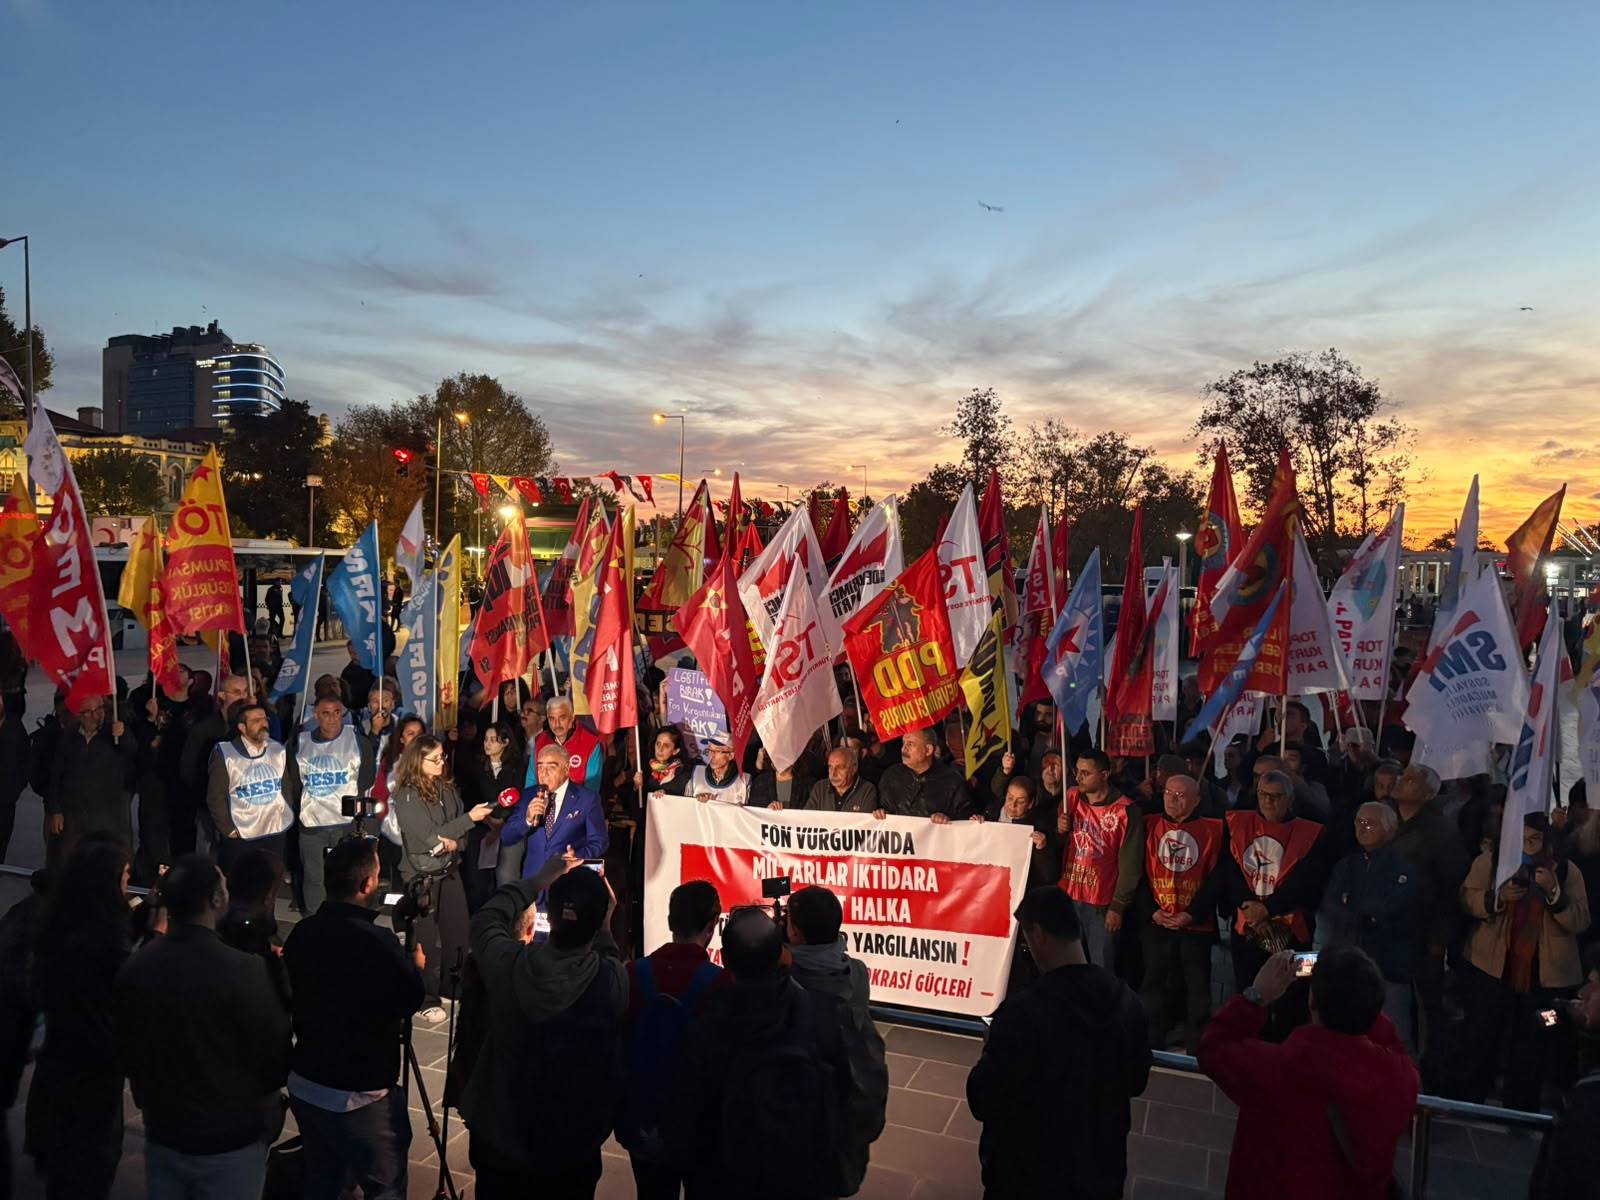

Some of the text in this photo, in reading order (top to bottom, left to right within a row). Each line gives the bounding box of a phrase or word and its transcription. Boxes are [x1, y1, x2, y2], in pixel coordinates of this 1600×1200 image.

[760, 824, 915, 855] FON VURGUNUNDA
[853, 860, 939, 893] İKTİDARA
[851, 896, 912, 924] HALKA
[853, 931, 957, 964] YARGILANSIN
[915, 972, 973, 998] GÜÇLERİ
